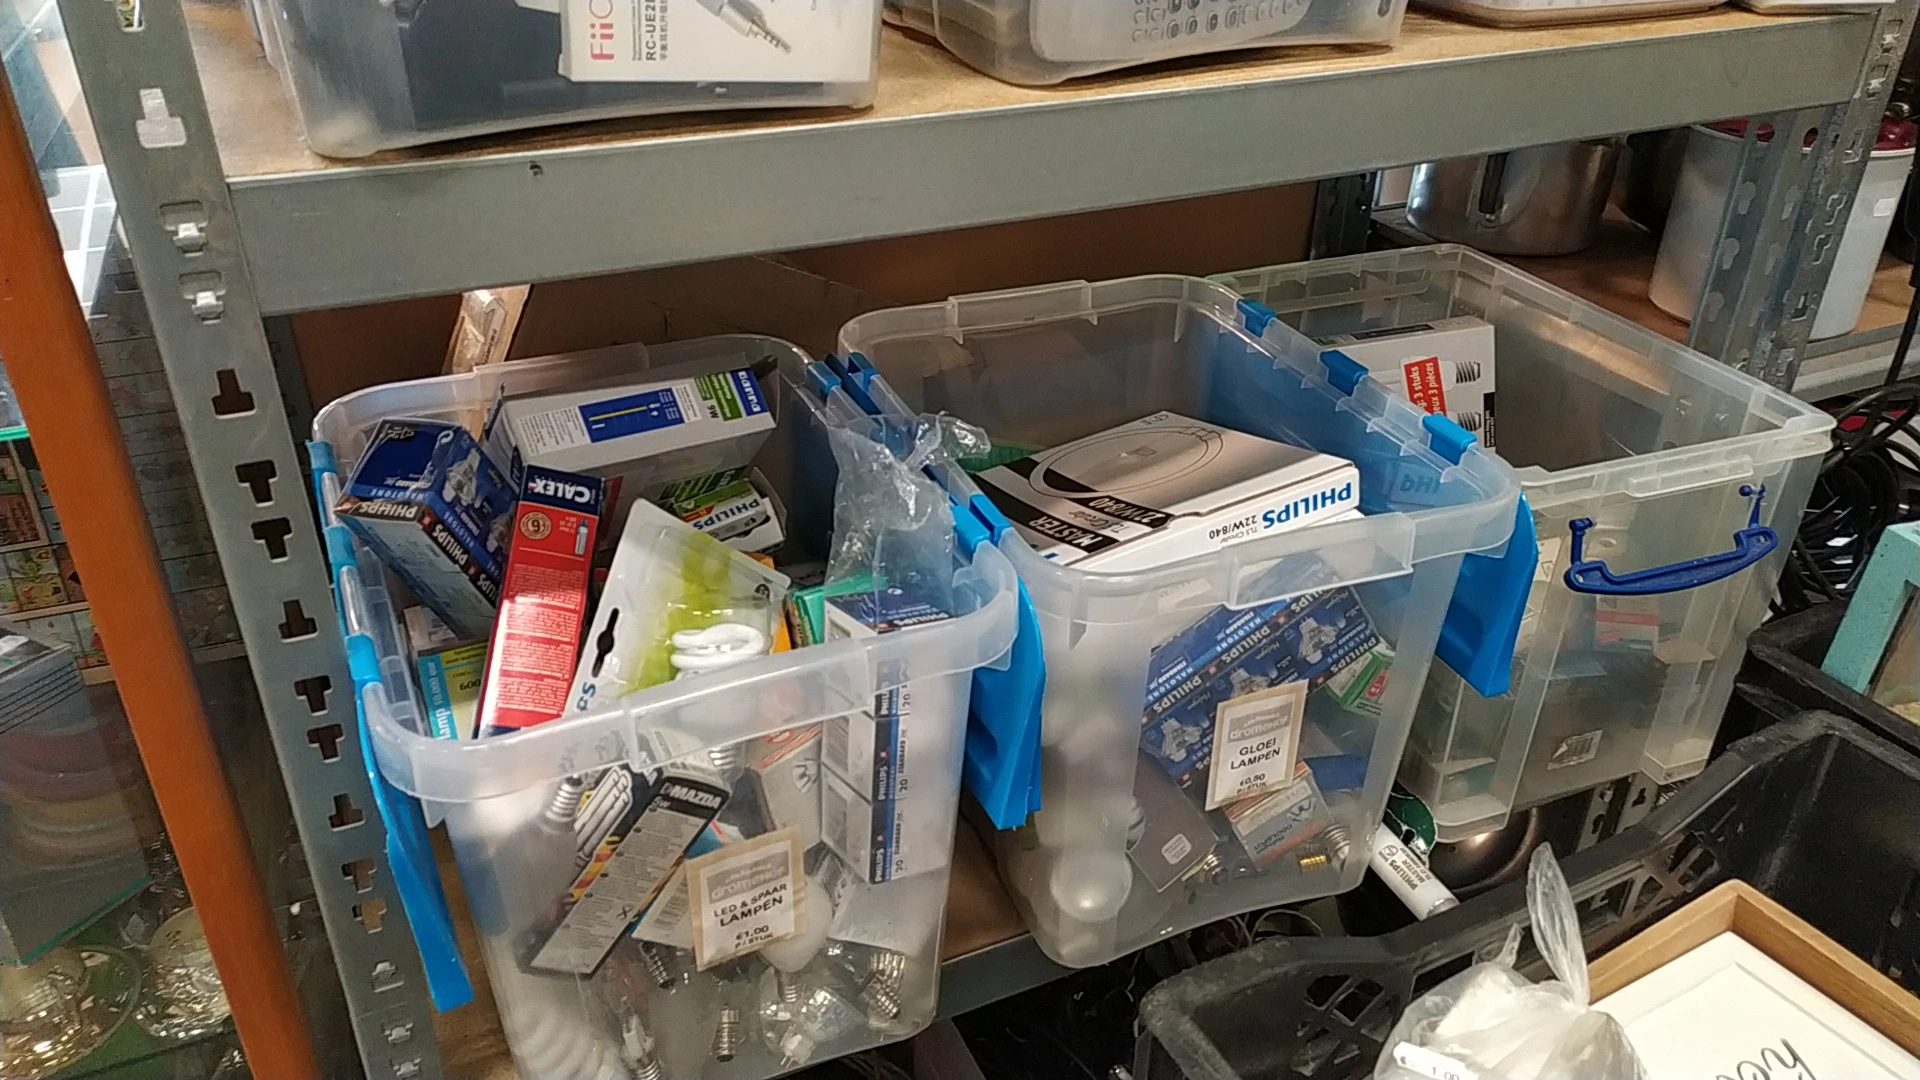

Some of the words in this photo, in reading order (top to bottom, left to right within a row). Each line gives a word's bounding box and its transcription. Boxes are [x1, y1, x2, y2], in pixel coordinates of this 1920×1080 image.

[1409, 366, 1422, 391] stuks
[1425, 362, 1439, 388] pièces
[707, 404, 719, 419] 9W
[533, 478, 591, 503] CALEX
[693, 498, 760, 530] PHILIPS
[1088, 497, 1166, 523] 22W/840
[1262, 482, 1352, 529] PHILIPS
[1029, 515, 1103, 547] MASTER
[1209, 515, 1257, 540] 22W/840
[432, 523, 469, 566] PHILIPS
[1216, 617, 1261, 652] HALOTONE
[1225, 610, 1255, 635] STANDARD
[1221, 626, 1271, 664] PHILIPS
[1330, 637, 1377, 673] PHILIPS
[1148, 666, 1194, 700] HALOTONE
[1158, 661, 1187, 684] STANDARD
[902, 693, 910, 708] 20
[1153, 676, 1202, 714] PHILIPS
[1230, 747, 1281, 770] LAMPEN
[1239, 737, 1276, 756] GLOEI
[878, 765, 888, 800] PHILIPS
[899, 778, 909, 792] 20
[670, 785, 722, 809] MAZDA
[874, 848, 884, 882] PHILIPS
[895, 859, 904, 873] 20
[1389, 859, 1419, 891] PHILIPS
[1401, 859, 1426, 883] MASTER
[714, 904, 737, 918] LED
[740, 900, 749, 909] &
[751, 883, 787, 905] SPAAR
[720, 895, 783, 927] LAMPEN
[736, 925, 769, 940] €1.00
[748, 932, 773, 944] STUK
